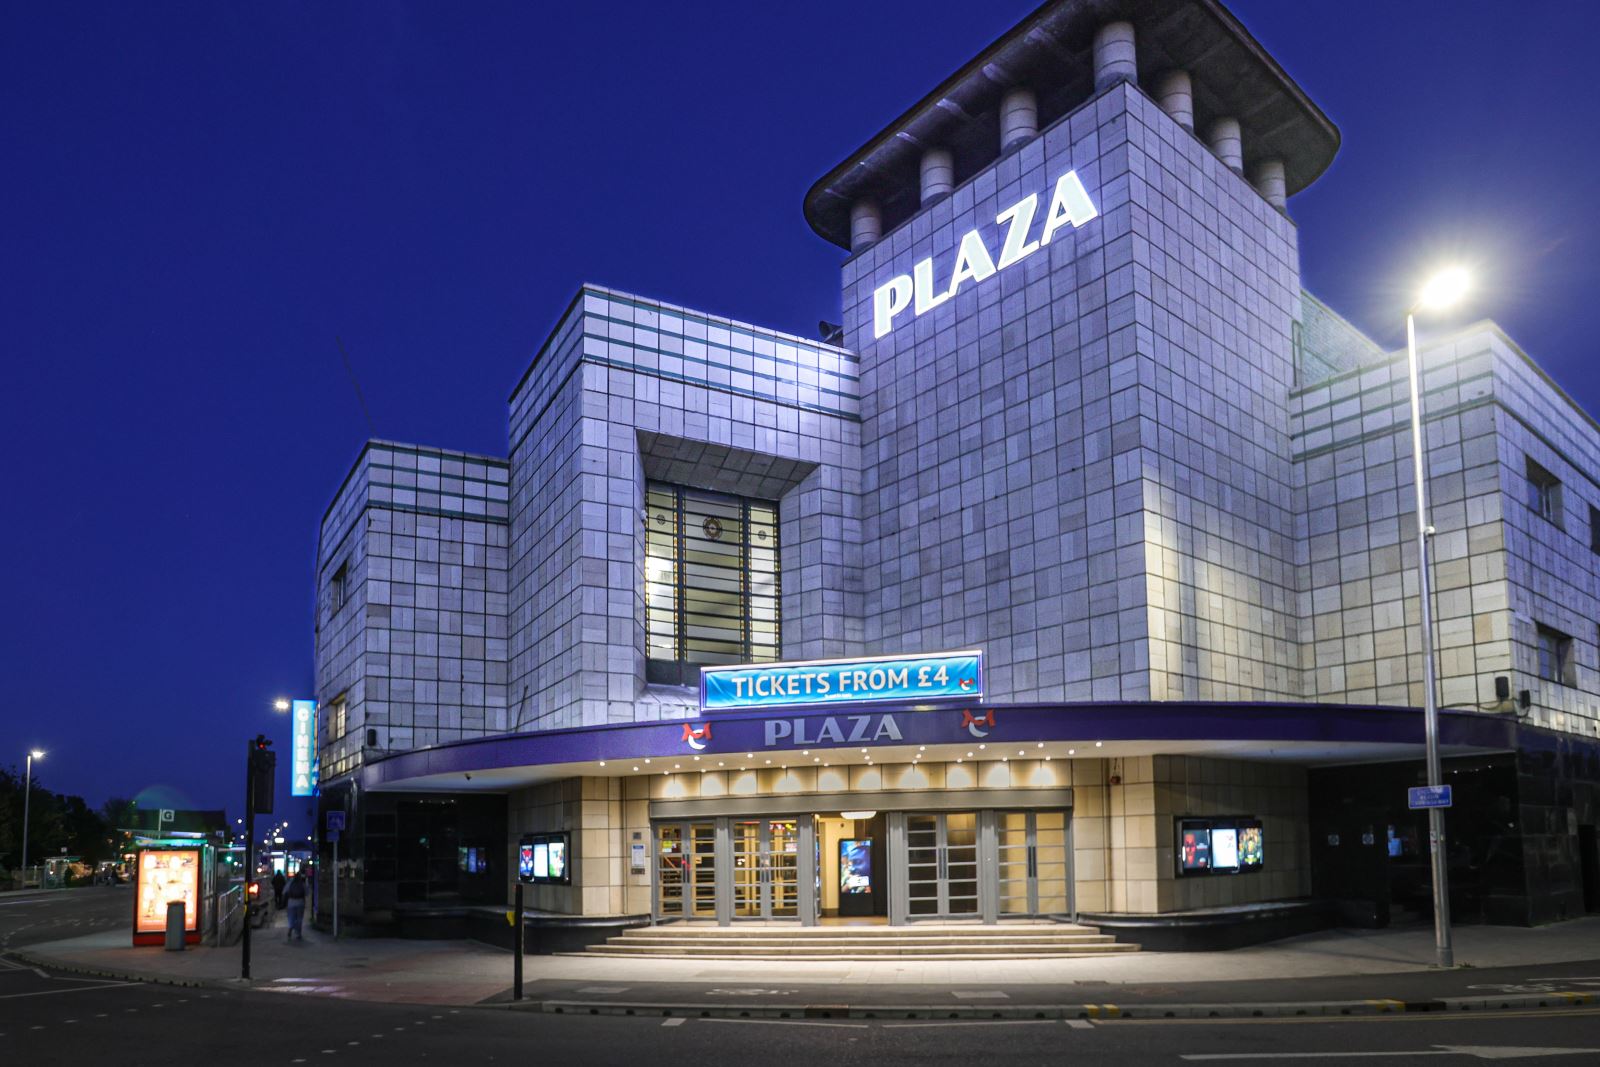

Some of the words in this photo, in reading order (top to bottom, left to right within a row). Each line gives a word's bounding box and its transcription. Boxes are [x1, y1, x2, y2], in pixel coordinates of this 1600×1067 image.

[874, 170, 1098, 339] PLAZA
[731, 672, 830, 698] TICKETS
[839, 669, 908, 692] FROM
[917, 665, 949, 687] £4
[764, 714, 903, 746] PLAZA
